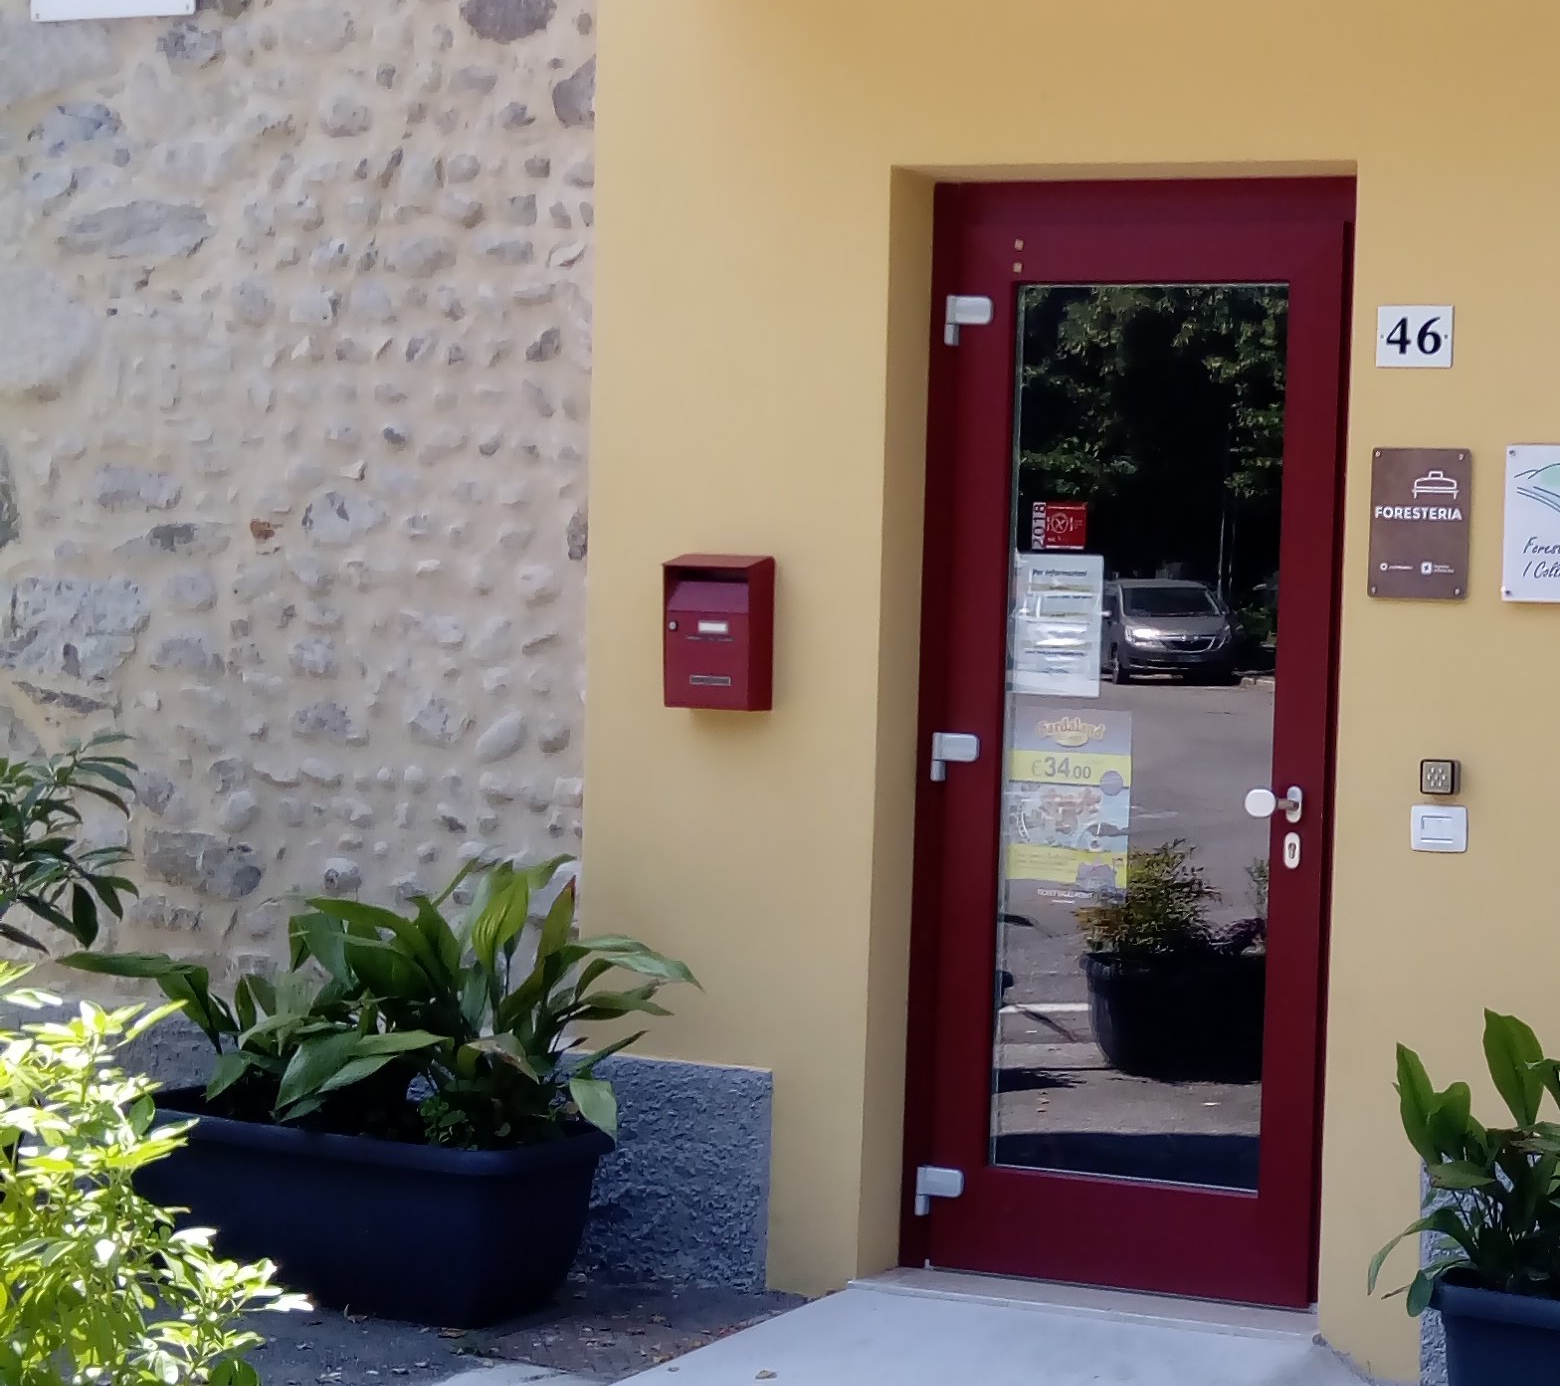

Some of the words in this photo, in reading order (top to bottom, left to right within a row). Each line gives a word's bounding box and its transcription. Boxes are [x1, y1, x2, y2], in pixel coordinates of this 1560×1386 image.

[1385, 316, 1443, 356] 46
[1032, 504, 1046, 549] 2018
[1374, 506, 1463, 521] FORESTERIA
